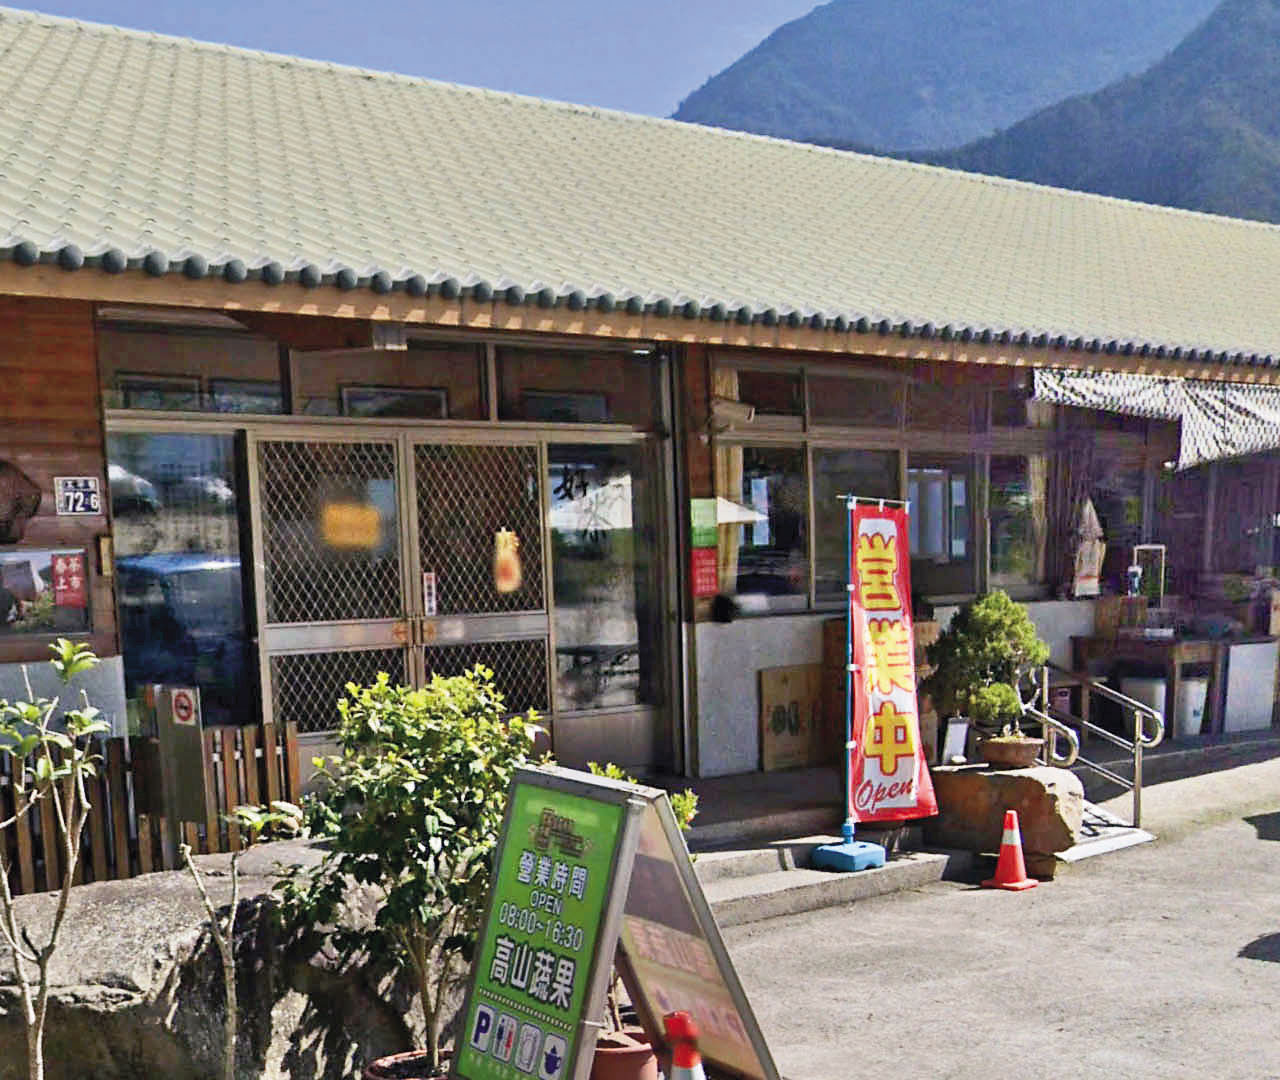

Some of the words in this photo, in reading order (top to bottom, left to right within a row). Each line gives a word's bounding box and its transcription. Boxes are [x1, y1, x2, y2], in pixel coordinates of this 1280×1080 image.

[857, 532, 917, 777] 營業中
[856, 778, 914, 816] Open
[517, 851, 588, 899] 營業時間
[499, 903, 585, 951] 08:00~16:30
[530, 890, 564, 916] OPEN
[489, 935, 576, 1008] 高山蔬果
[473, 1011, 491, 1043] P
